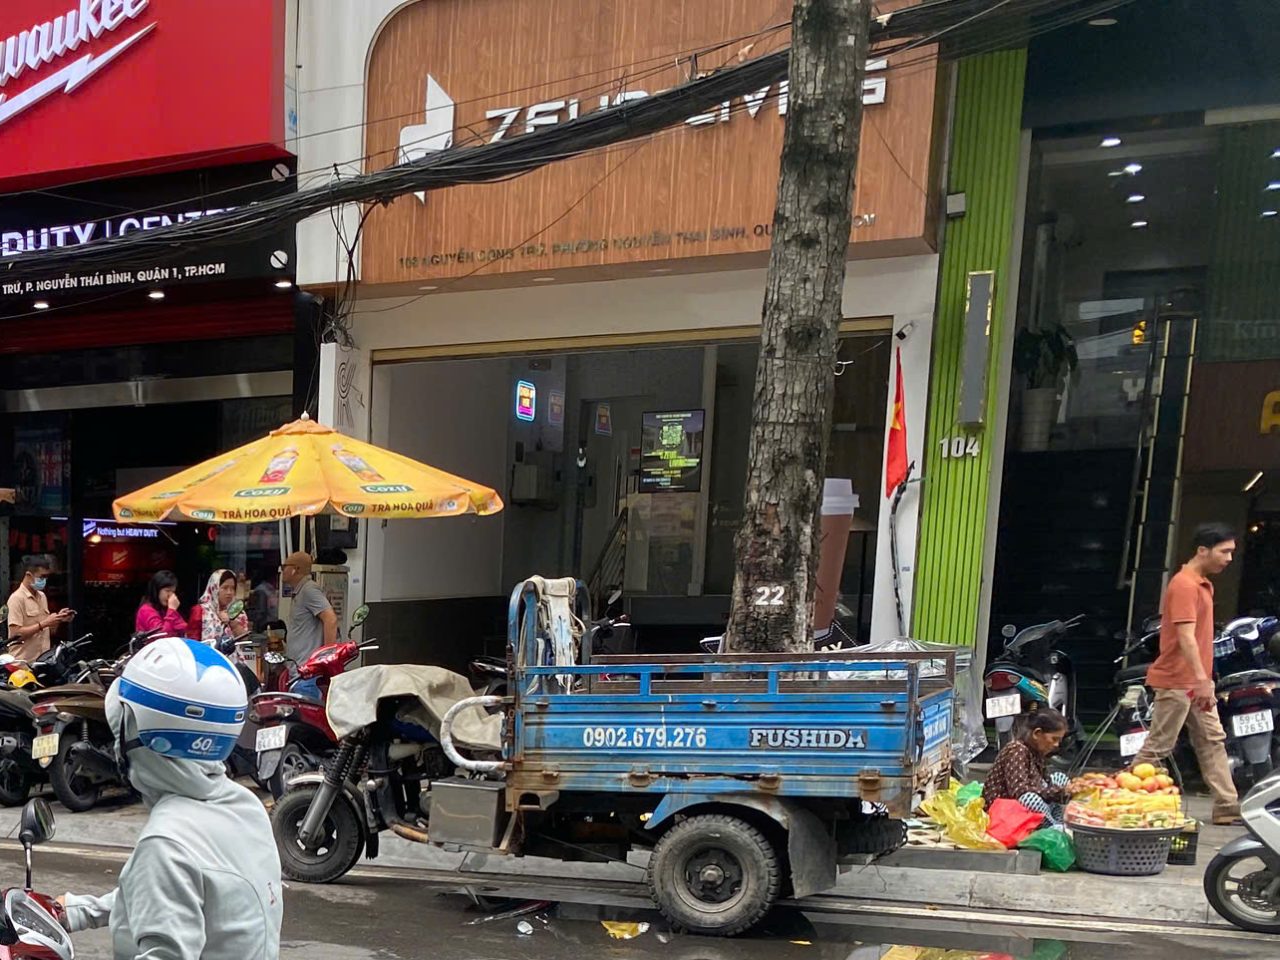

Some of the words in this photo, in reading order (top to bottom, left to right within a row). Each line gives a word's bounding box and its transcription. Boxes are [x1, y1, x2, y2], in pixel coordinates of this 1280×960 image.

[1, 222, 96, 257] DUTY
[25, 282, 34, 292] P.
[36, 273, 78, 292] NGUYỄN
[80, 269, 104, 288] THÁI
[106, 269, 135, 285] BÌNH,
[137, 266, 169, 282] QUẬN
[172, 267, 182, 279] 1,
[184, 262, 226, 277] TP.HCM
[938, 436, 981, 459] 104
[244, 508, 268, 518] HOA
[392, 501, 414, 512] HOA
[126, 528, 144, 538] HEAVY
[755, 585, 786, 606] 22
[191, 736, 213, 751] 60
[582, 726, 707, 748] 0902.679.276
[749, 728, 866, 750] FUSHIDA
